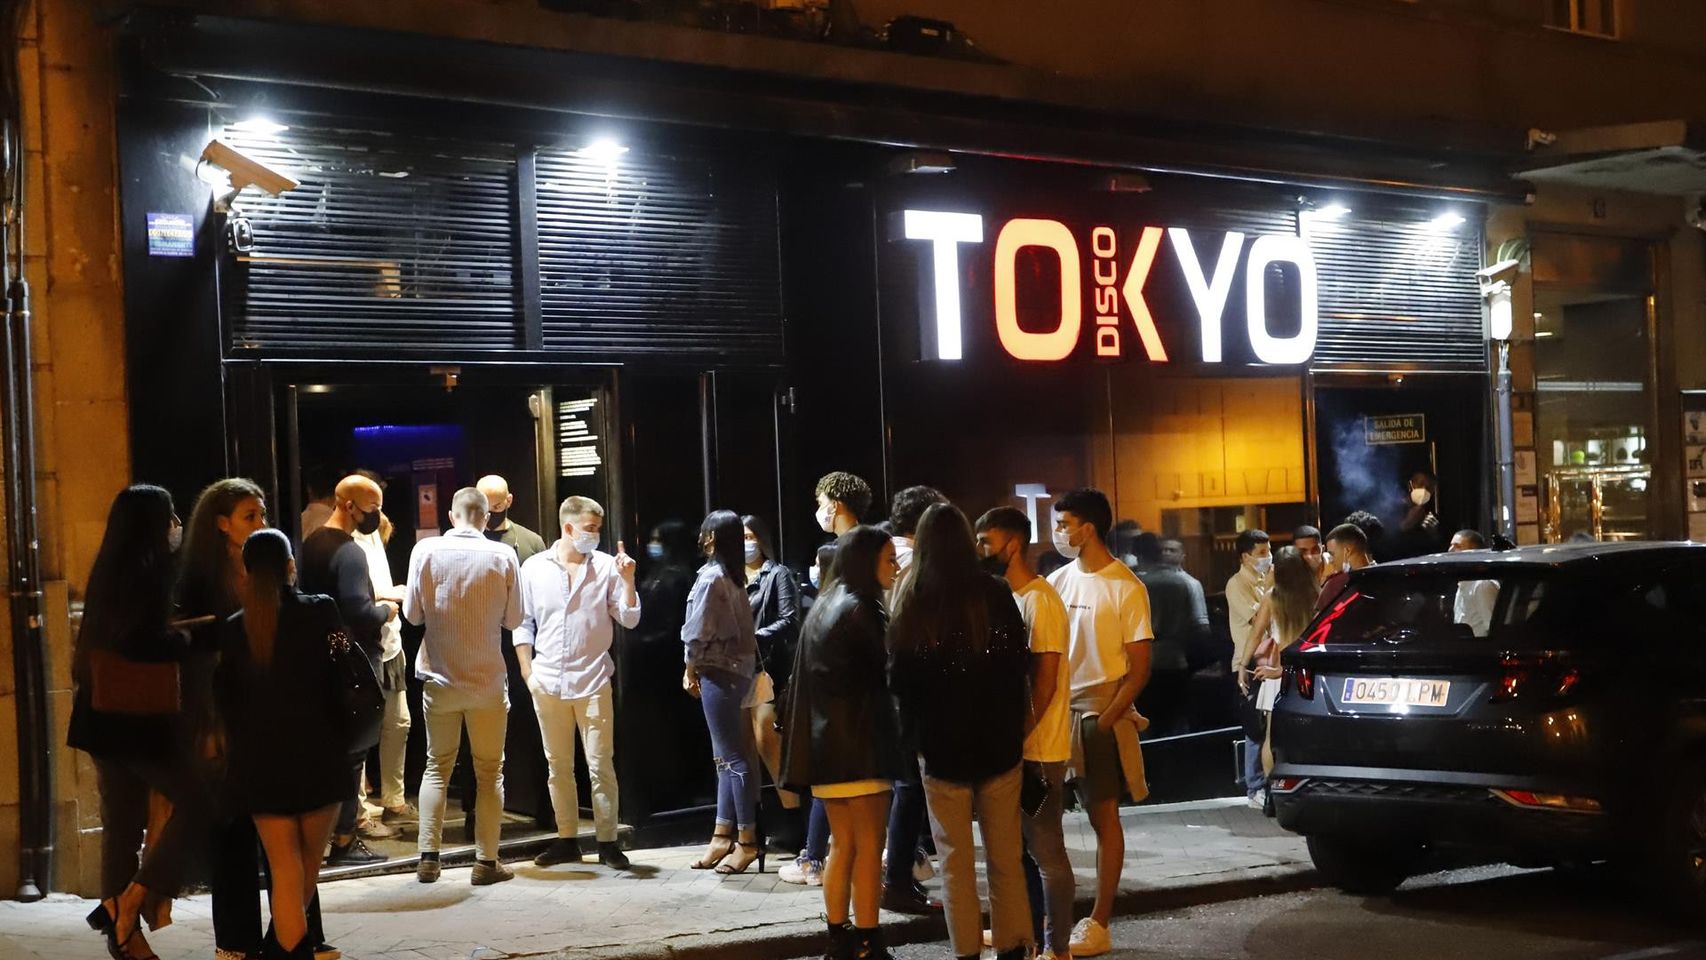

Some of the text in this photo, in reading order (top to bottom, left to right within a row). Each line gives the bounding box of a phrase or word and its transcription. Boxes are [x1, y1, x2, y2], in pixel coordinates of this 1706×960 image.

[904, 209, 1318, 365] TOKYO
[1092, 226, 1120, 356] DISCO
[1370, 430, 1419, 440] EMERGENCIA
[1375, 418, 1414, 428] SALIDA DE
